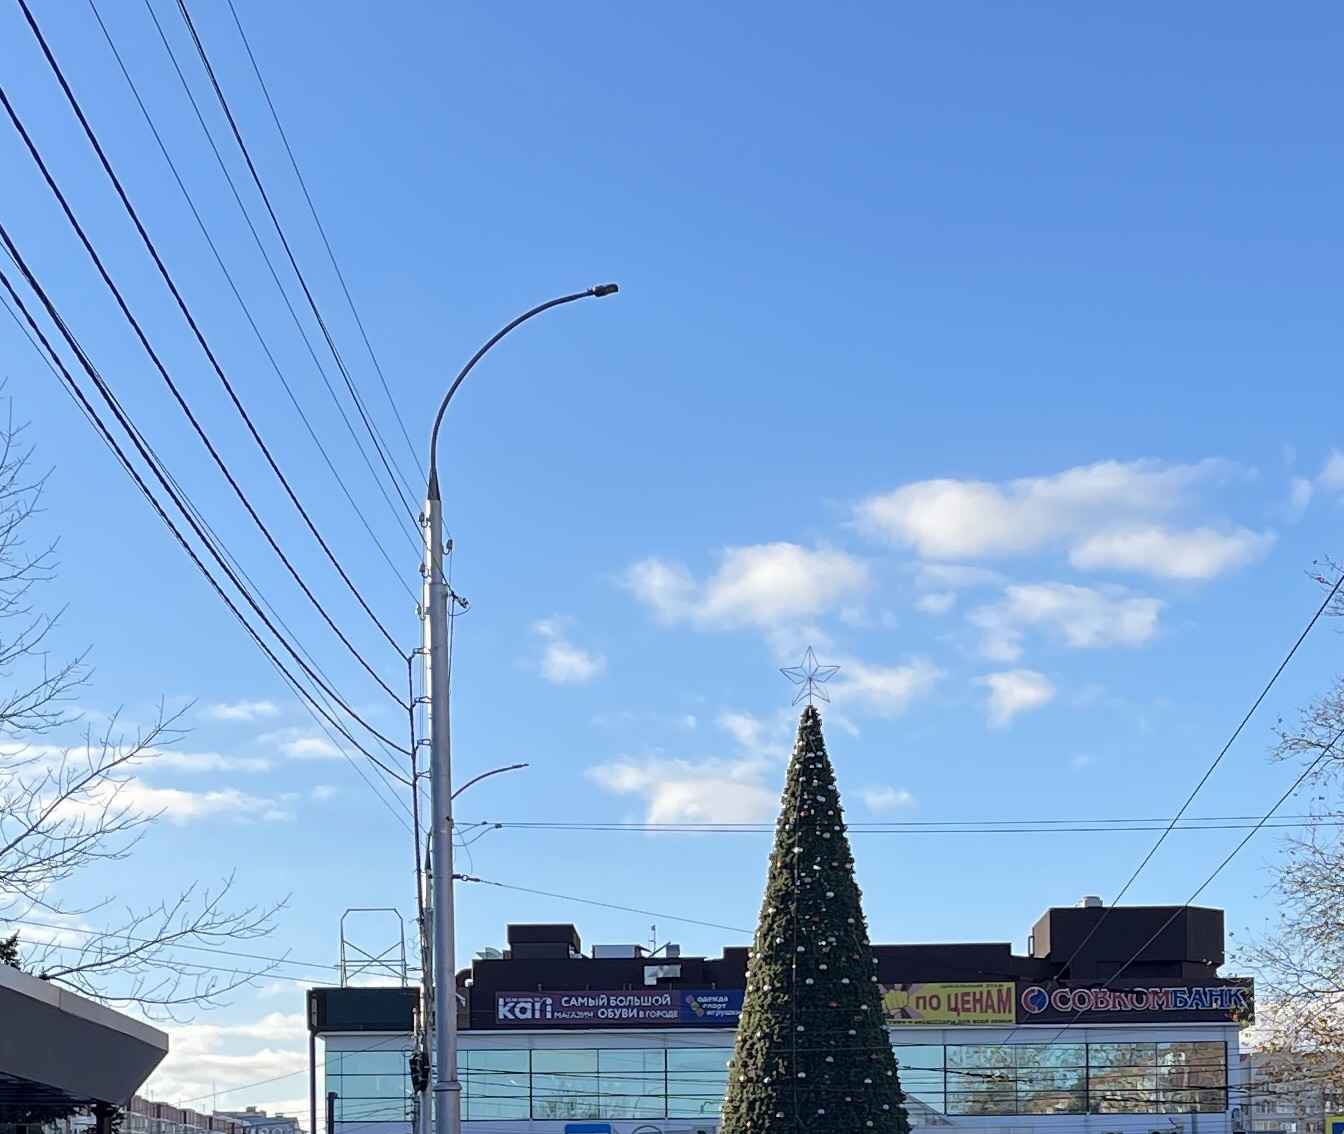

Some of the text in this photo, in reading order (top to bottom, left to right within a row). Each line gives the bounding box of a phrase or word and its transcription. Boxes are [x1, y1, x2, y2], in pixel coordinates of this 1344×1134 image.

[498, 997, 553, 1019] kari
[561, 993, 671, 1007] САМЫЙ БОЛЬШОЙ
[914, 988, 1013, 1016] ПО ЦЕНАМ
[1051, 985, 1247, 1012] СОВКОМБАНК
[597, 1008, 638, 1019] ОБУВИ
[646, 1010, 679, 1019] ГОРОДЕ
